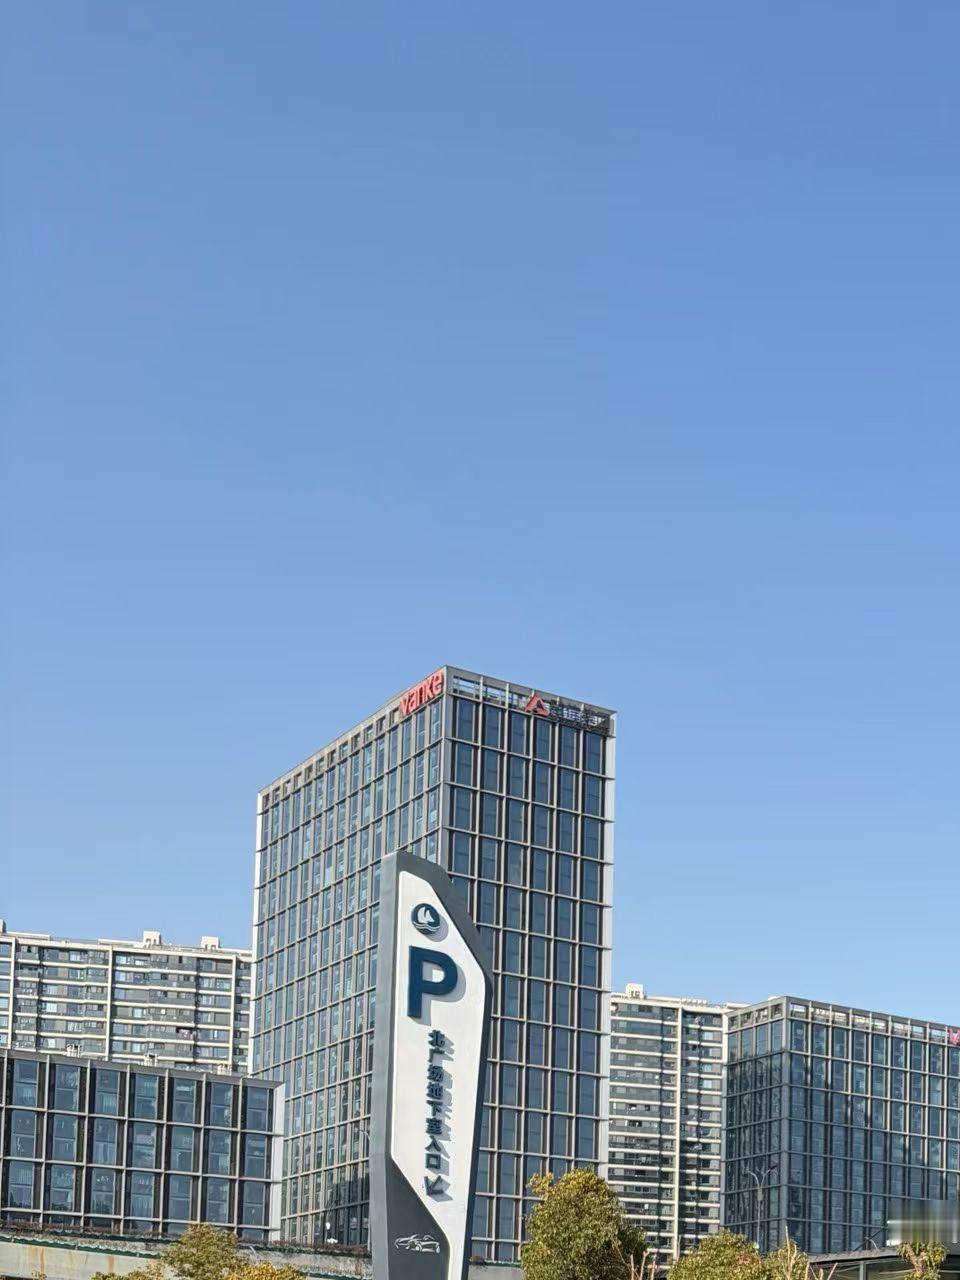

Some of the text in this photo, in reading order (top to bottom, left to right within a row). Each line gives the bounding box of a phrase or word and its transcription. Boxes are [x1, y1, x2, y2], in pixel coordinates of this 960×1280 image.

[401, 671, 444, 718] vanke
[407, 945, 458, 1019] P
[425, 1029, 446, 1170] 北广场地下室入口
